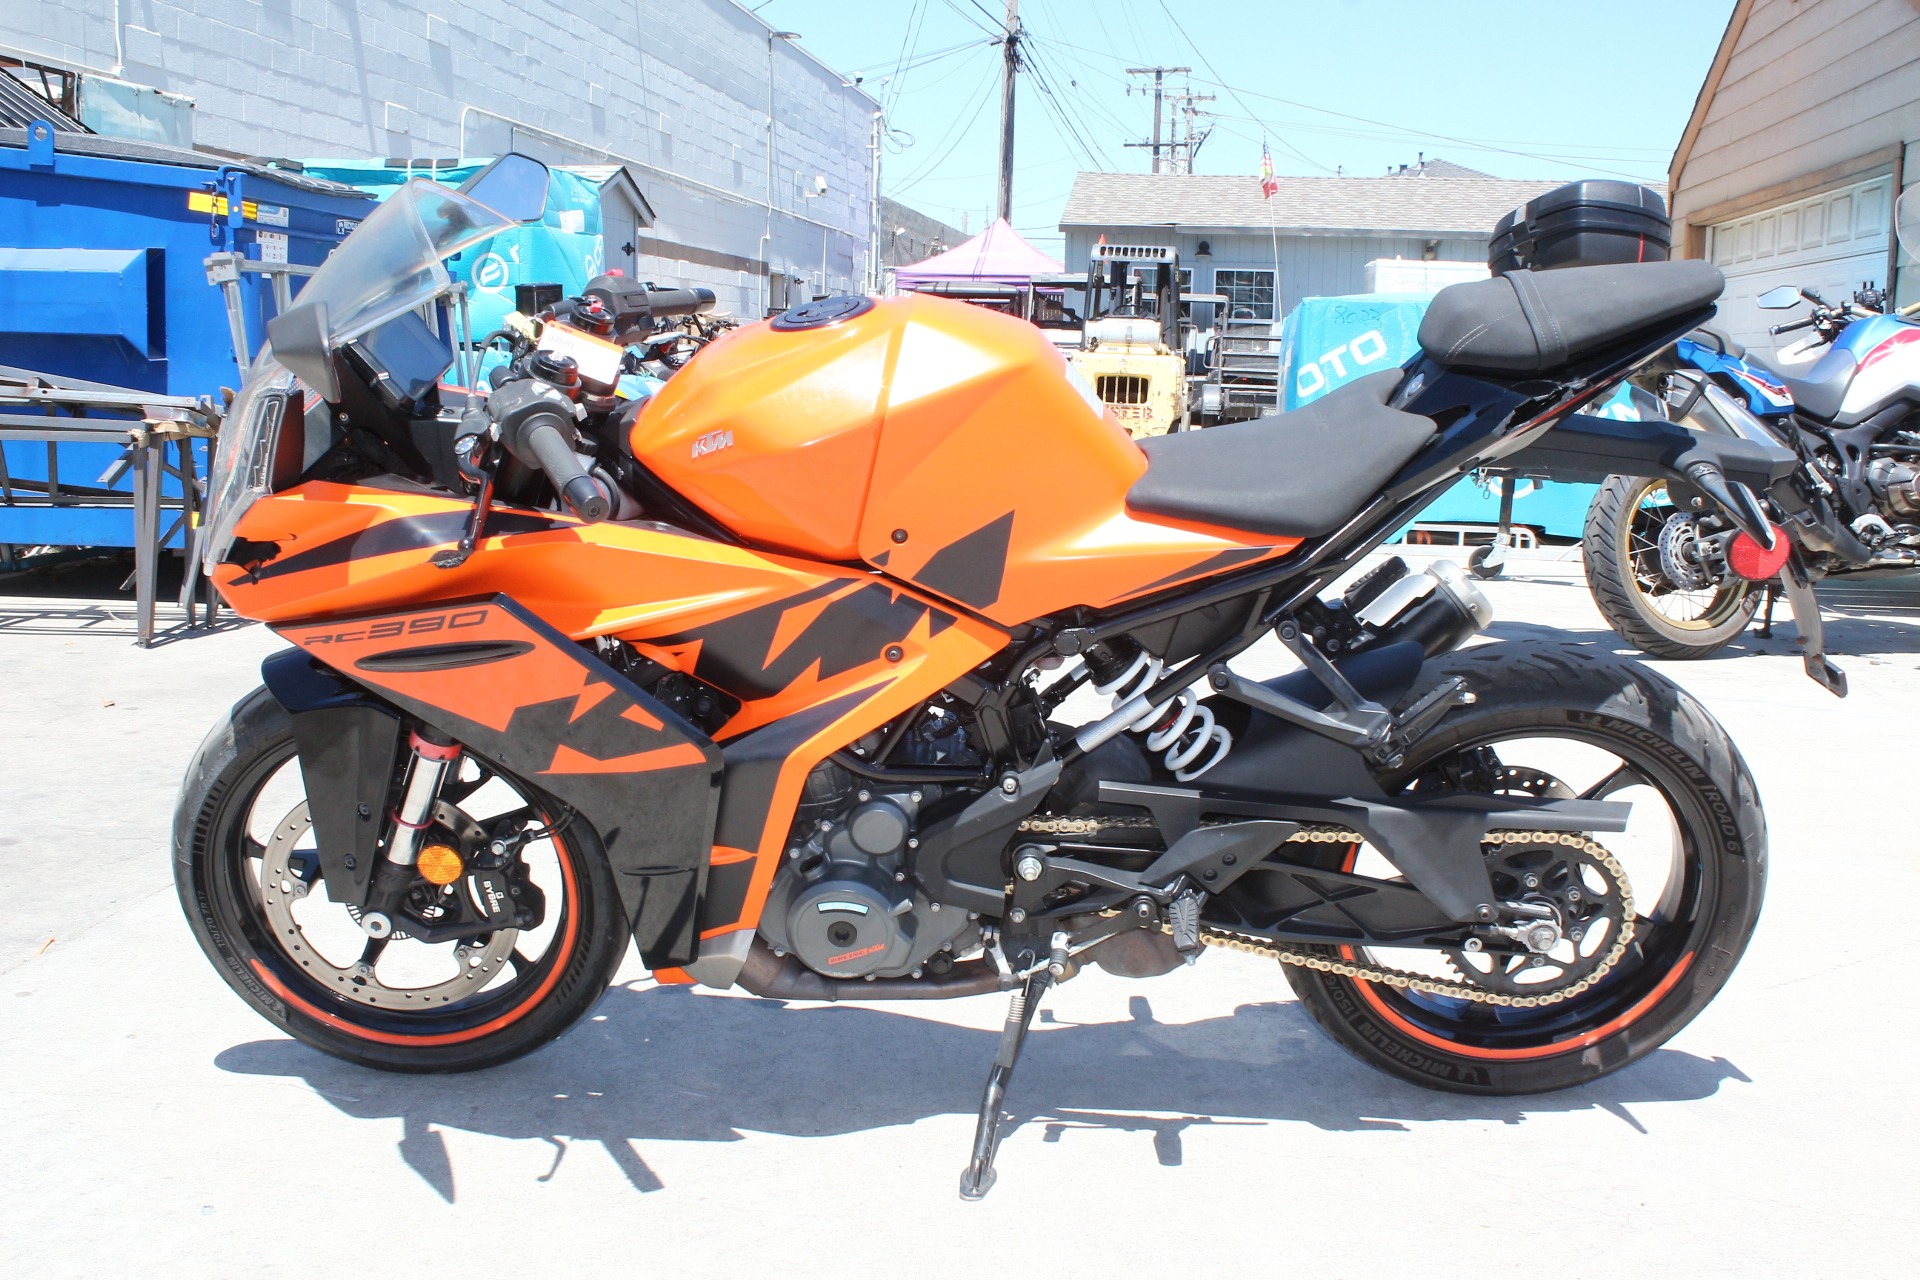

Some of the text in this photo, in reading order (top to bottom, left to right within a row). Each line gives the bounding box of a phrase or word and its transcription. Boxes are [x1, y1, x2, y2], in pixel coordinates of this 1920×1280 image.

[1104, 405, 1153, 420] STER
[691, 429, 733, 459] KTM
[1605, 718, 1741, 854] MICHELIN ROAD 6
[483, 880, 501, 914] BYBRE
[206, 916, 226, 949] 110/70
[226, 955, 273, 1006] MICHELIN
[1324, 973, 1451, 1078] MICHELIN 150/6
